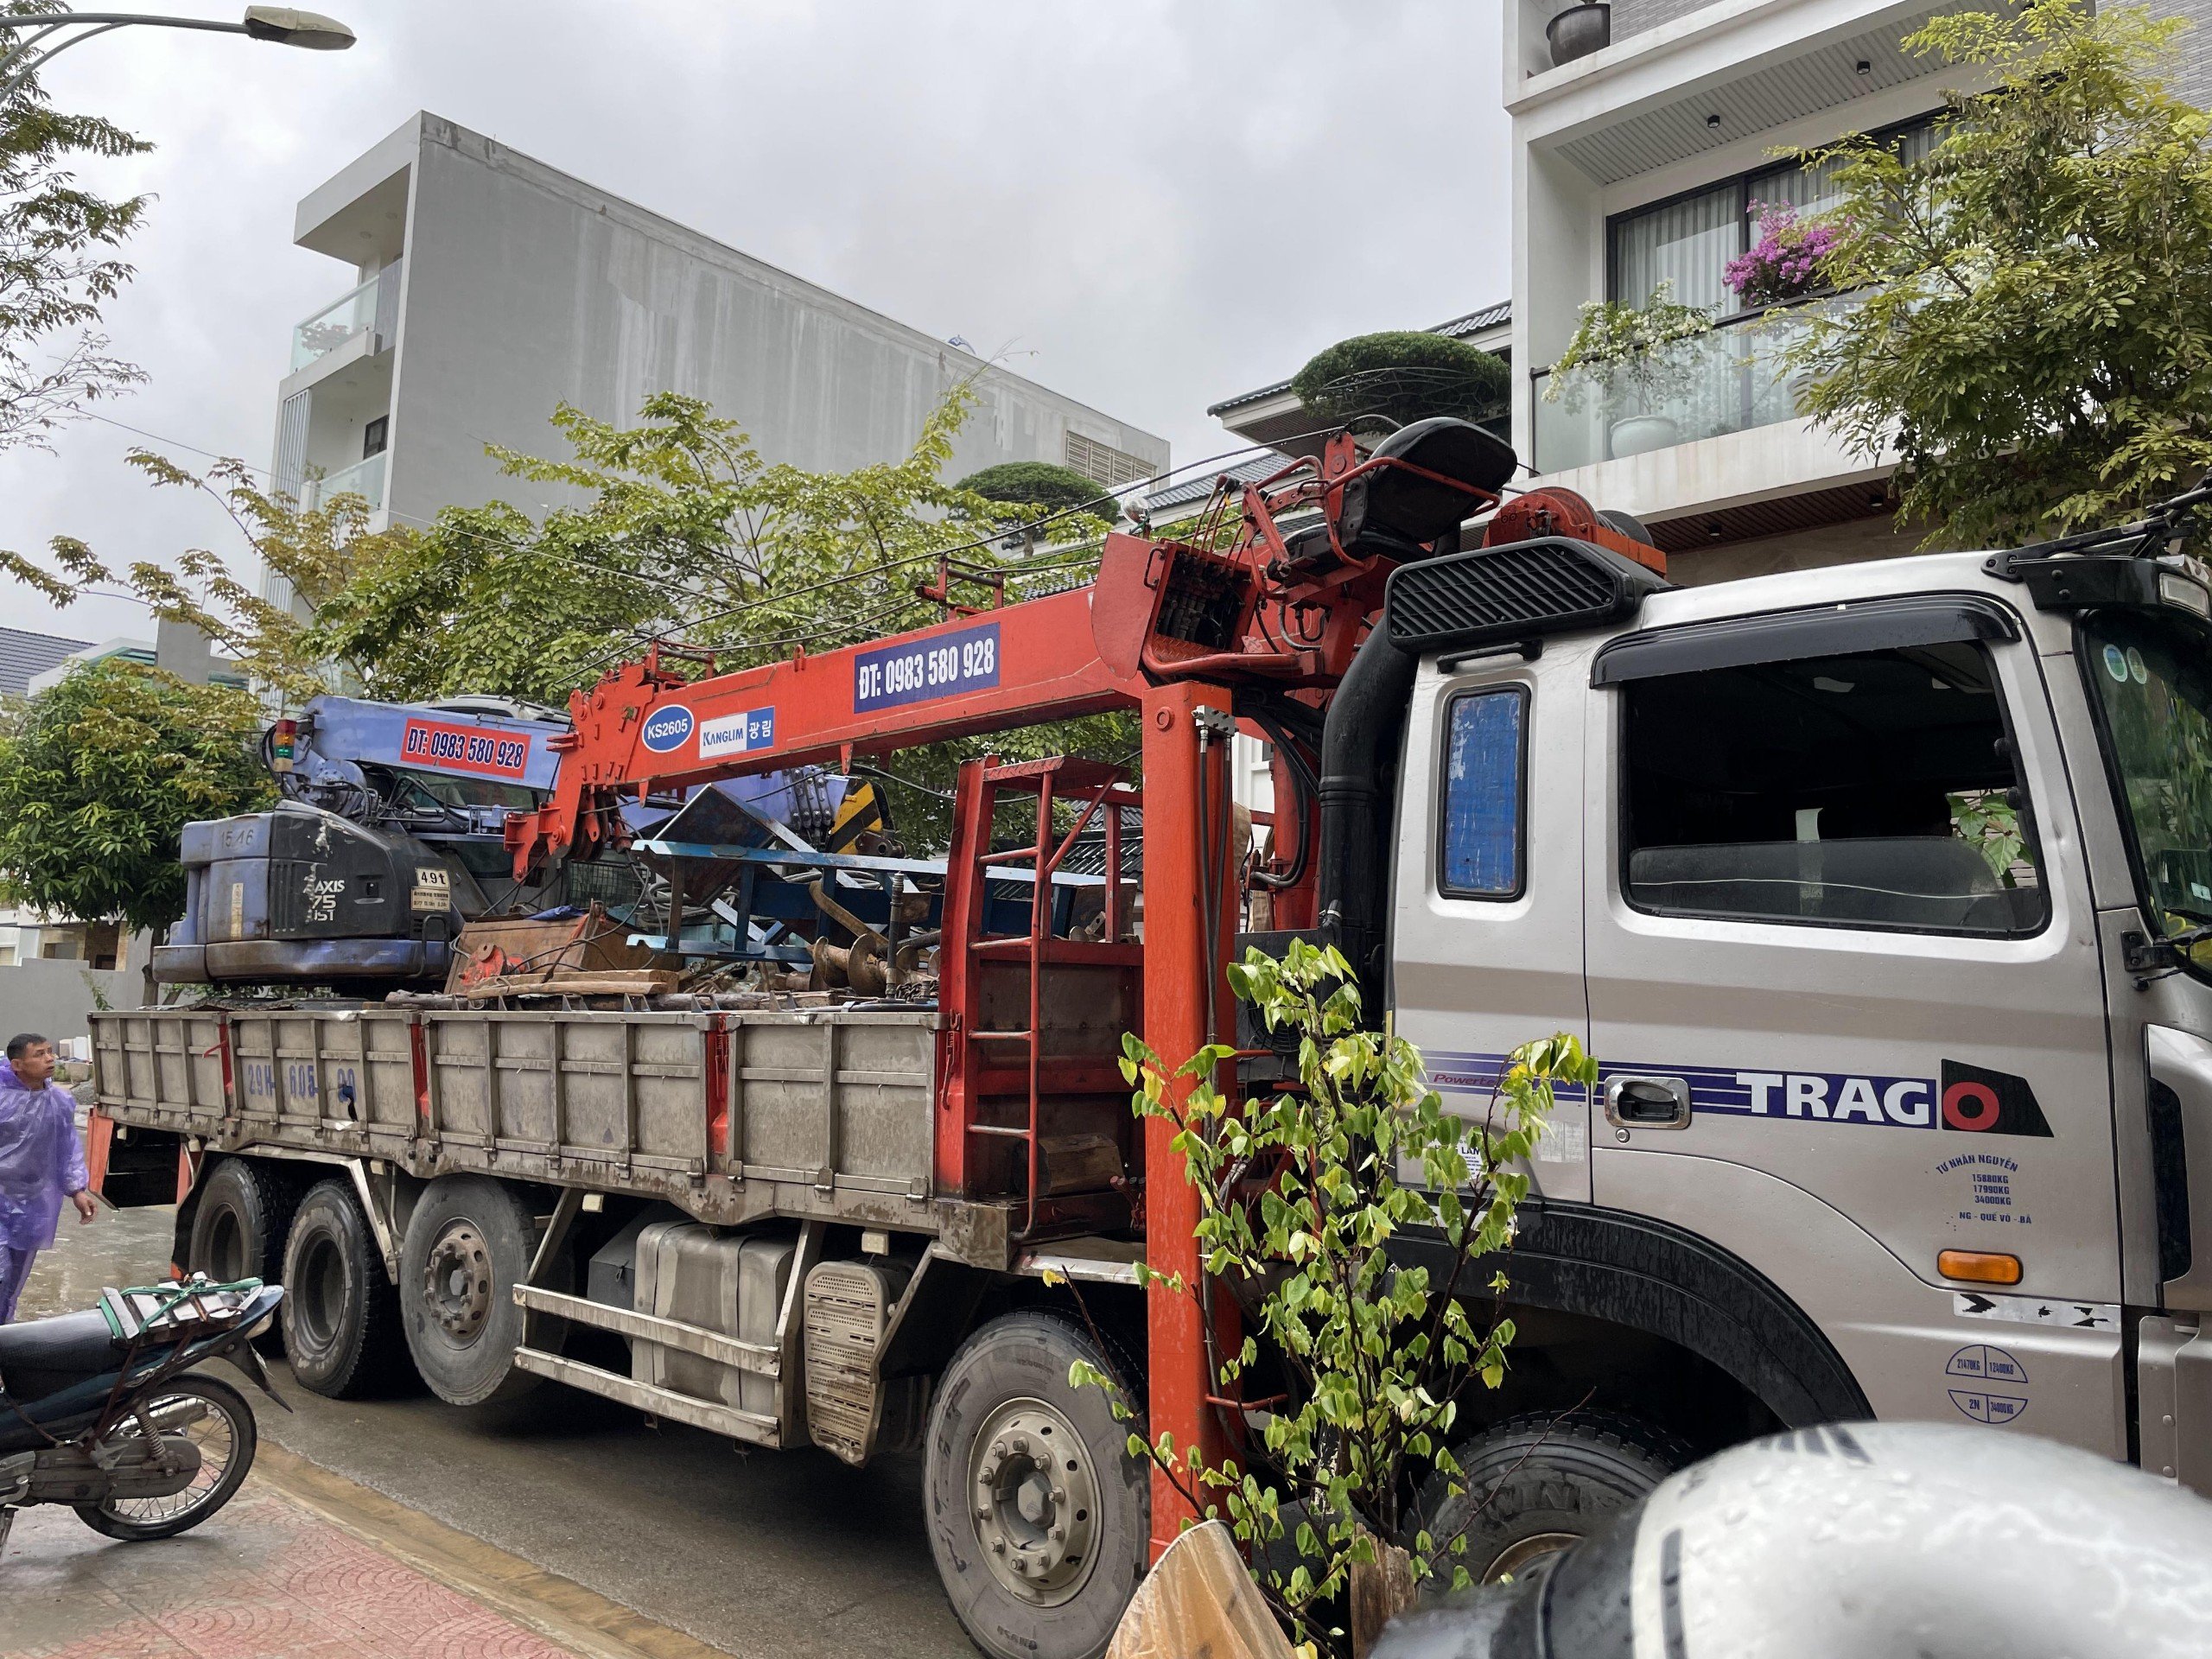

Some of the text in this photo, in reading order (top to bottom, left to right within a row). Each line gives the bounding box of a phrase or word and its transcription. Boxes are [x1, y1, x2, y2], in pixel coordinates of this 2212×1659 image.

[857, 638, 995, 700] ĐT: 0983 580 928
[647, 718, 689, 740] KS2605
[748, 720, 772, 740] 광림
[406, 727, 524, 769] ĐT: 0983 580 928
[312, 894, 337, 909] 75
[1433, 1073, 1496, 1086] Powerte
[1974, 1195, 2012, 1205] 34000KG
[1969, 1399, 1980, 1410] 2N
